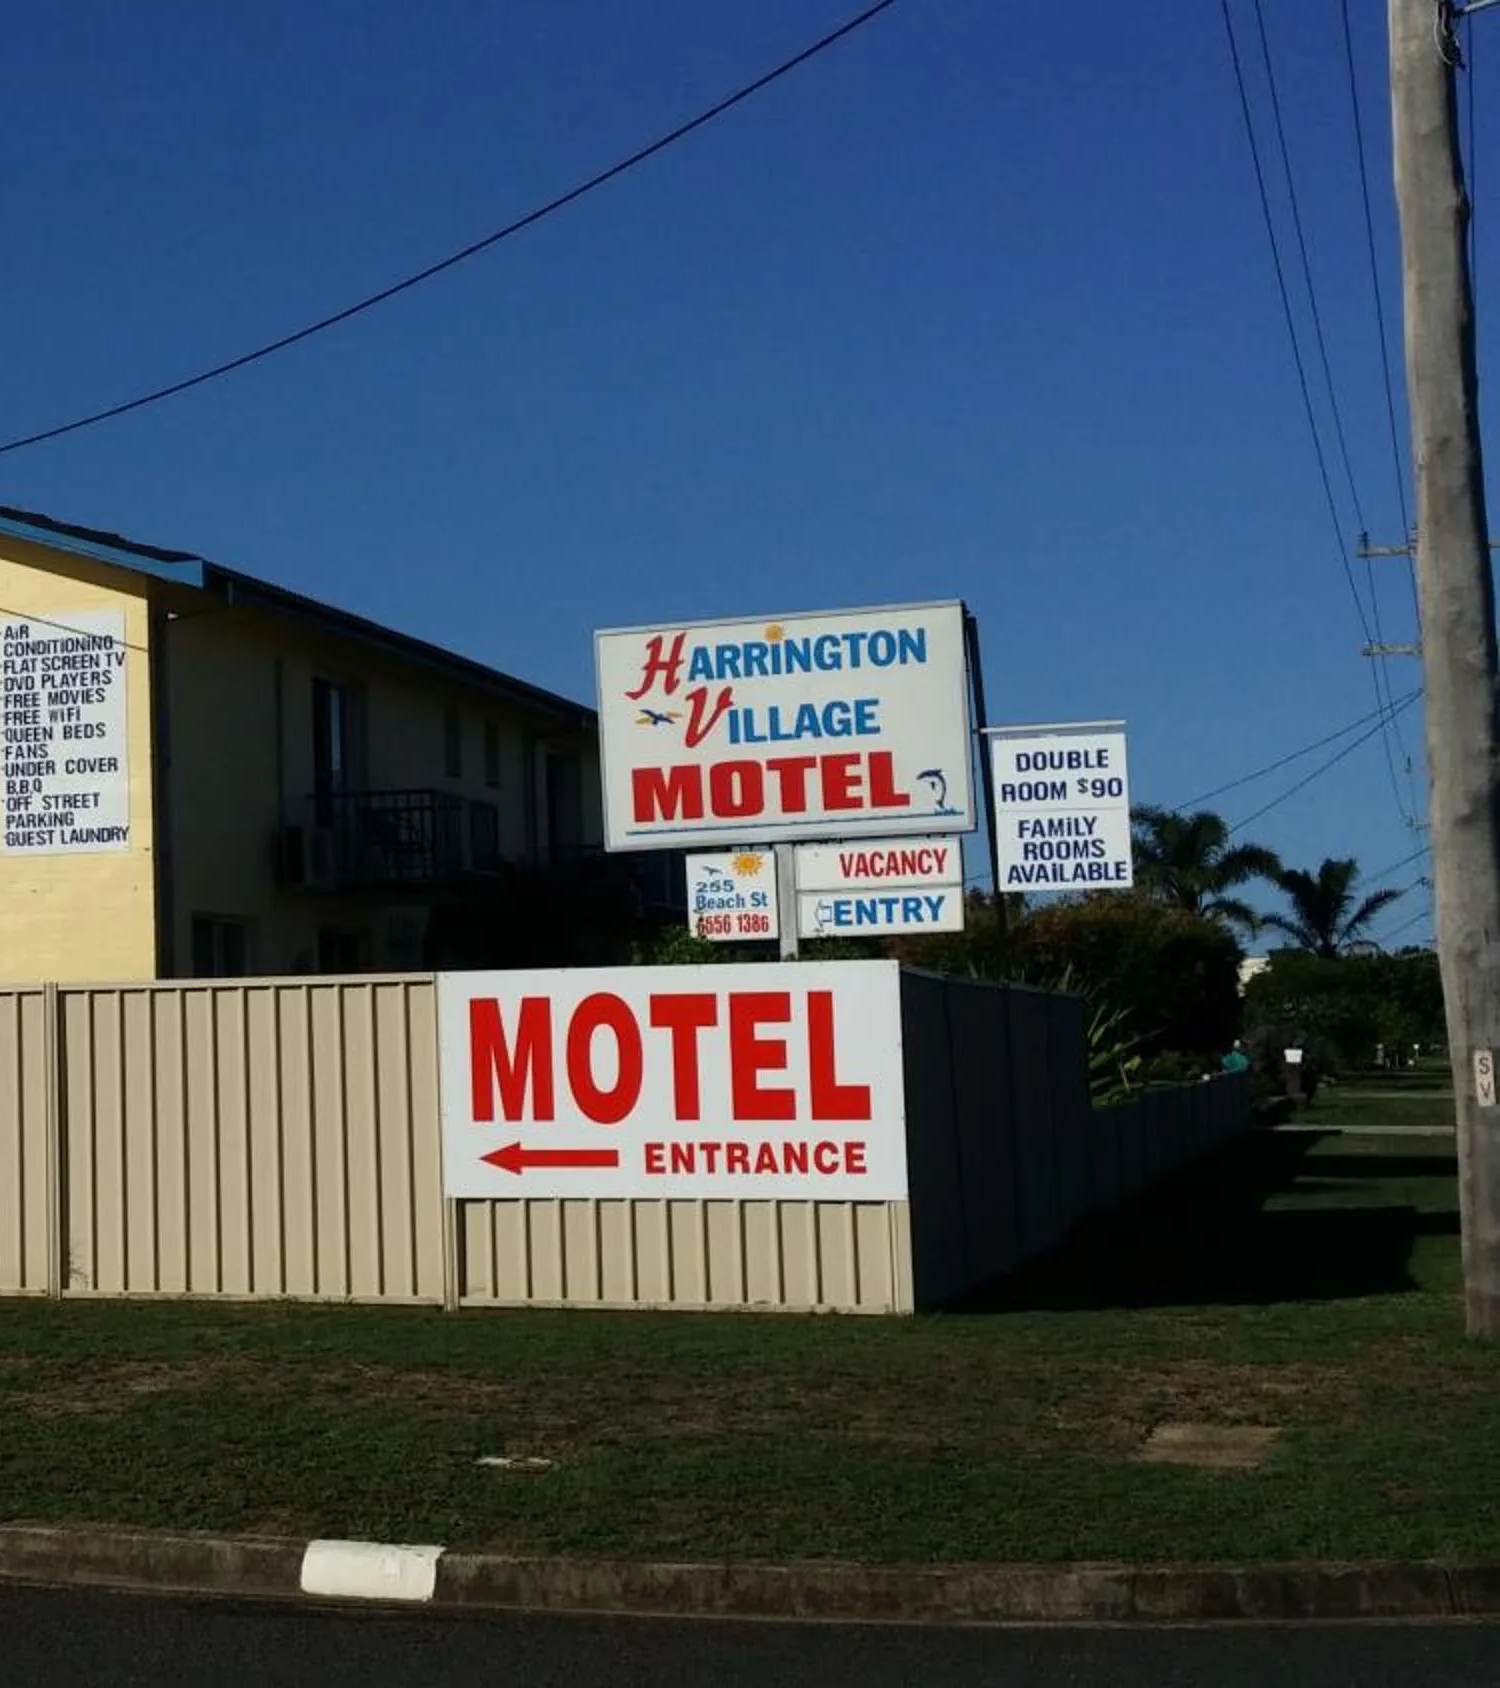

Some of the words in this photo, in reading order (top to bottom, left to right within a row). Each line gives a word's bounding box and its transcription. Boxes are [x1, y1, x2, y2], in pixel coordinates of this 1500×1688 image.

[3, 658, 39, 675] FLAT
[41, 654, 101, 673] SCREEN
[104, 651, 126, 667] TV
[624, 627, 928, 700] HARRINGTON
[3, 675, 36, 693] DVD
[41, 669, 113, 689] PLAYERS
[3, 691, 41, 709] FREE
[47, 687, 106, 707] MOVIES
[3, 709, 41, 726] FREE
[683, 686, 881, 749] VILLAGE
[4, 726, 54, 744] QUEEN
[62, 722, 107, 741] BEDS
[4, 743, 49, 761] FANS
[1015, 749, 1109, 773] DOUBLE
[4, 759, 57, 778] UNDER
[64, 757, 119, 775] COVER
[631, 751, 911, 823] MOTEL
[1001, 780, 1067, 803] ROOM
[1076, 777, 1124, 799] $90
[5, 795, 33, 813] OFF
[41, 792, 101, 811] STREET
[4, 811, 75, 830] PARKING
[4, 829, 55, 847] GUEST
[60, 825, 131, 845] LAUNDRY
[1023, 838, 1107, 861] ROOMS
[839, 848, 949, 879] VACANCY
[695, 879, 736, 893] 255
[695, 893, 746, 910] Beach
[750, 891, 769, 908] St
[832, 895, 946, 927] ENTRY
[695, 913, 732, 936] 6556
[736, 913, 770, 933] 1386
[469, 990, 872, 1125] MOTEL
[643, 1141, 868, 1177] ENTRANCE
